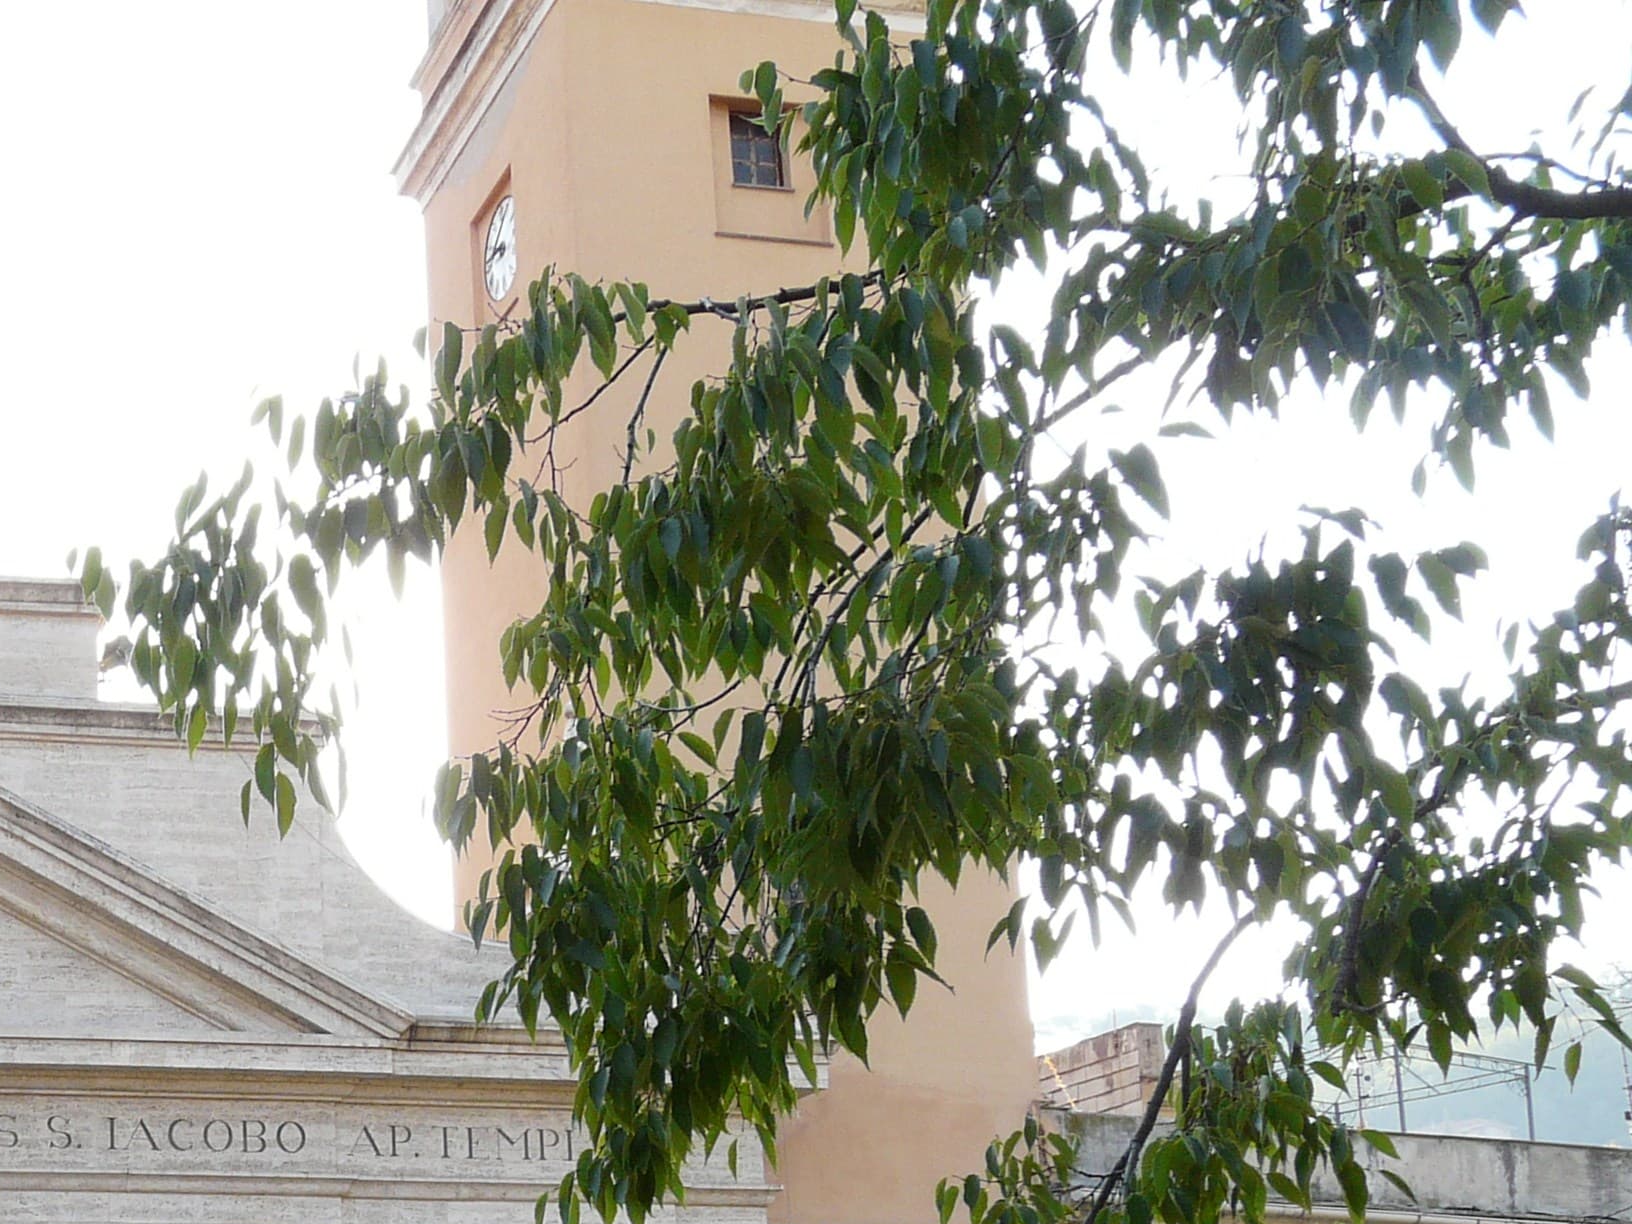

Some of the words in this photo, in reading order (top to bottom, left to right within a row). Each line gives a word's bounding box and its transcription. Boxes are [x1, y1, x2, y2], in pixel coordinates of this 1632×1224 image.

[47, 1114, 83, 1150] S.
[106, 1116, 307, 1155] IACOBO
[347, 1124, 420, 1158] AP.
